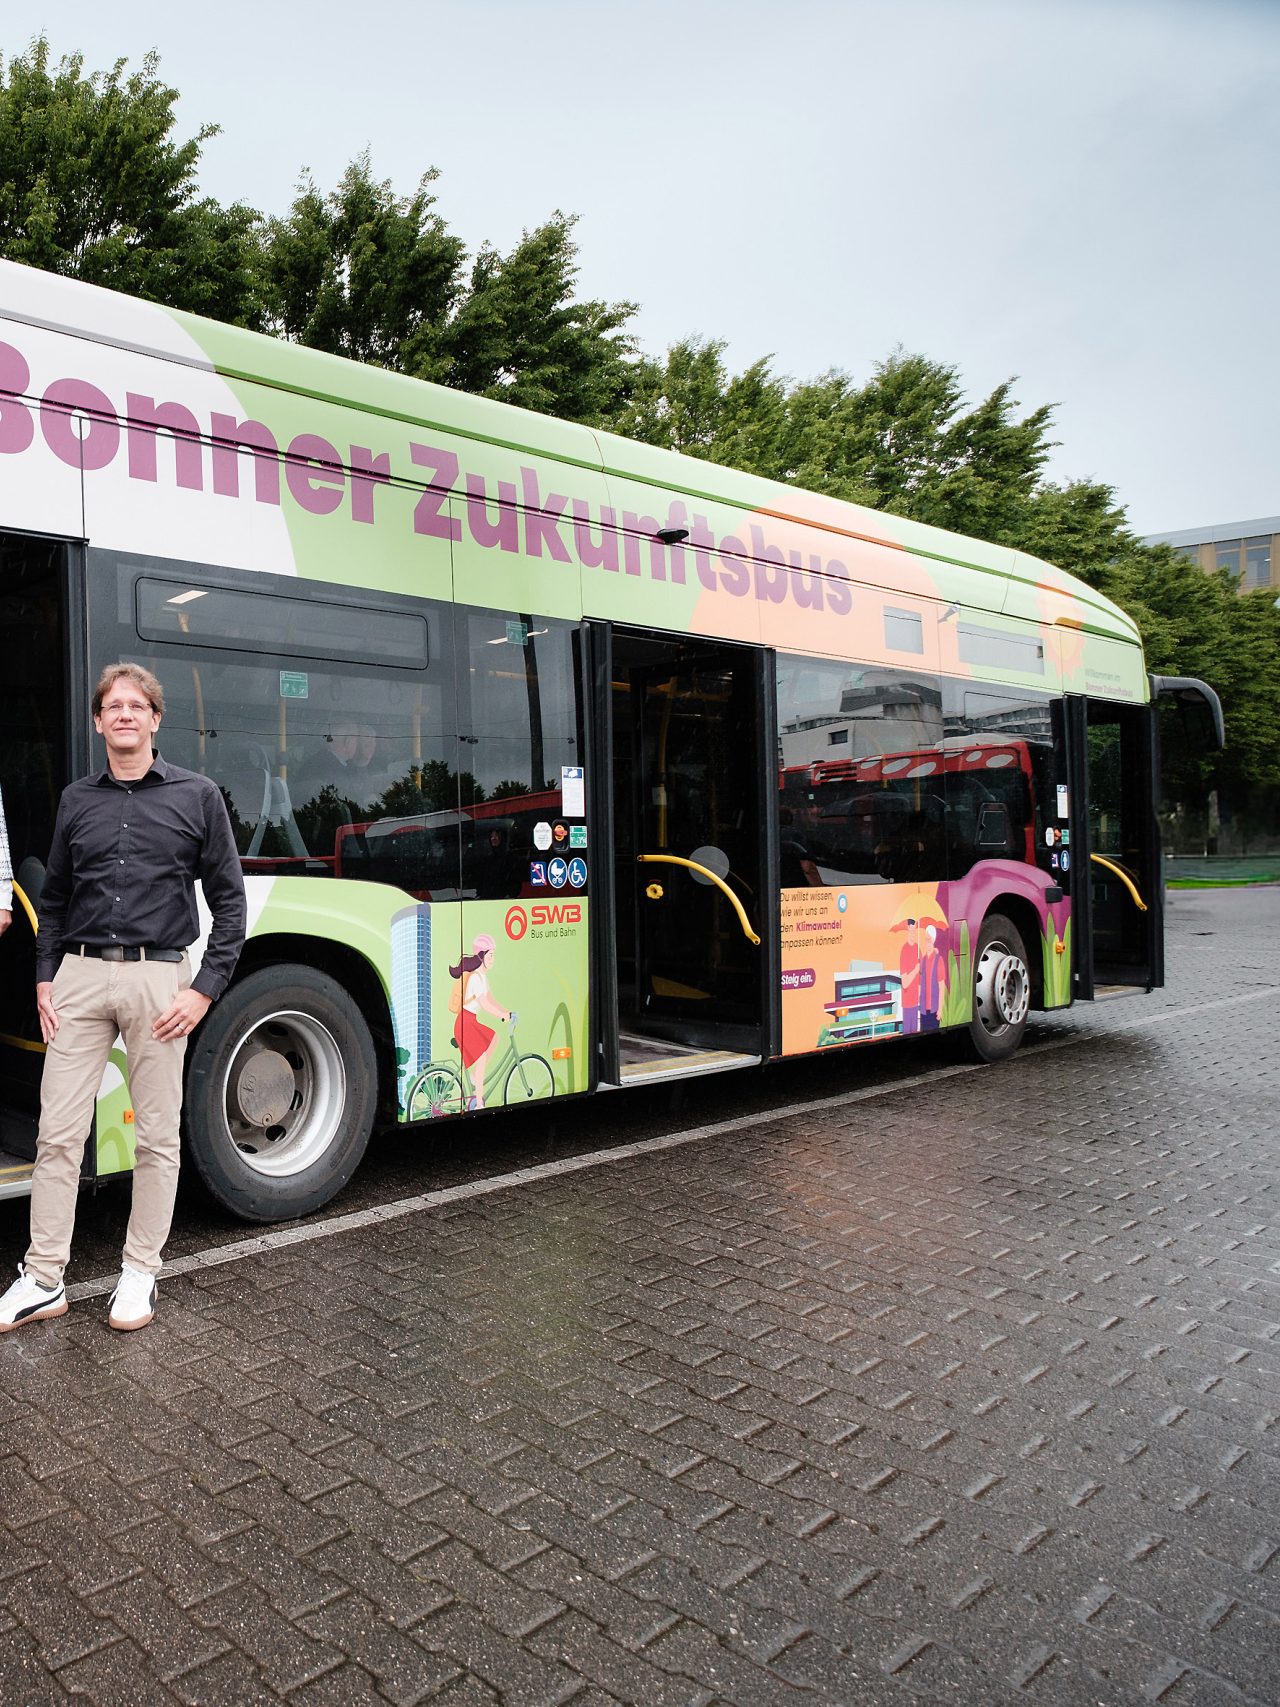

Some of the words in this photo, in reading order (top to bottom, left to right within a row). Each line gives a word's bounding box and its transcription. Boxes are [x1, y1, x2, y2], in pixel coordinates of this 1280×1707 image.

[408, 441, 853, 616] Zukunftsbus
[531, 904, 582, 925] SWB
[806, 907, 817, 915] uns
[820, 907, 828, 915] an
[796, 920, 842, 932] Klimawandel
[531, 929, 543, 939] Bus
[545, 928, 558, 938] und
[560, 927, 577, 937] Bahn
[816, 934, 843, 946] können?
[781, 973, 799, 987] Steig
[800, 972, 813, 984] ein.
